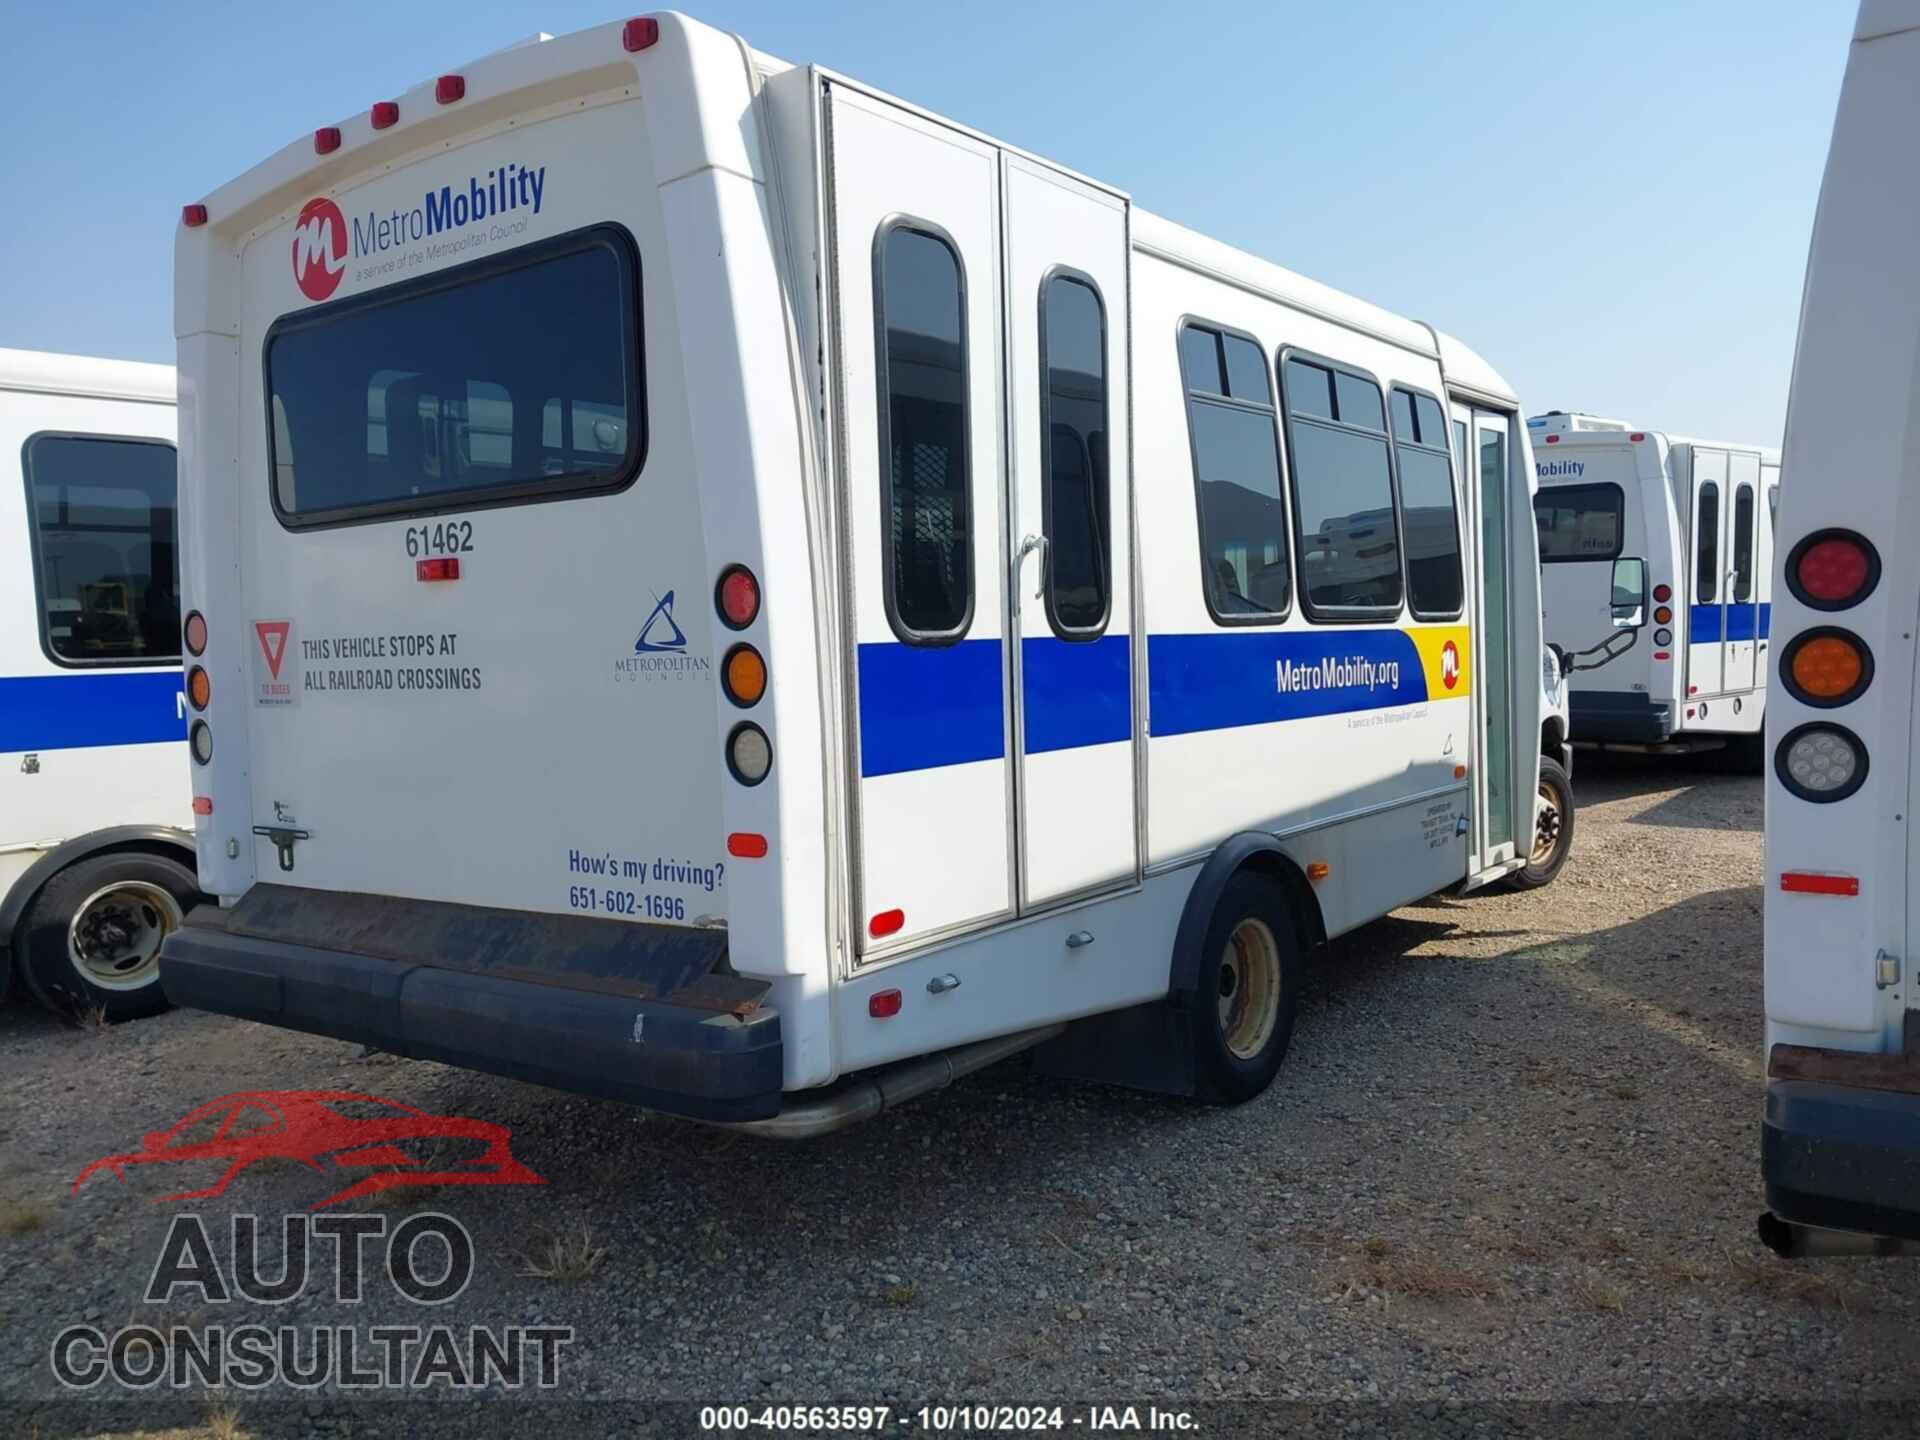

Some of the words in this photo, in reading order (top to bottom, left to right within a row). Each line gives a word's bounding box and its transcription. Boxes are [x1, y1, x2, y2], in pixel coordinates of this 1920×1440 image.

[354, 164, 545, 258] MetroMobility
[356, 271, 361, 281] a
[363, 260, 394, 279] service
[397, 256, 406, 270] of
[408, 252, 423, 267] the
[425, 231, 487, 264] Metropolitan
[490, 217, 528, 241] Council
[406, 520, 474, 557] 61462
[302, 639, 330, 660] THIS
[333, 636, 386, 658] VEHICLE
[390, 634, 435, 657] STOPS
[440, 634, 457, 656] AT
[615, 656, 710, 672] METROPOLITAN
[304, 670, 326, 690] ALL
[329, 669, 393, 691] RAILROAD
[397, 667, 482, 690] CROSSINGS
[1276, 656, 1399, 693] MetroMobility.org
[569, 849, 618, 876] How's
[623, 860, 648, 885] my
[653, 857, 725, 892] driving?
[570, 886, 685, 921] 651-602-1696
